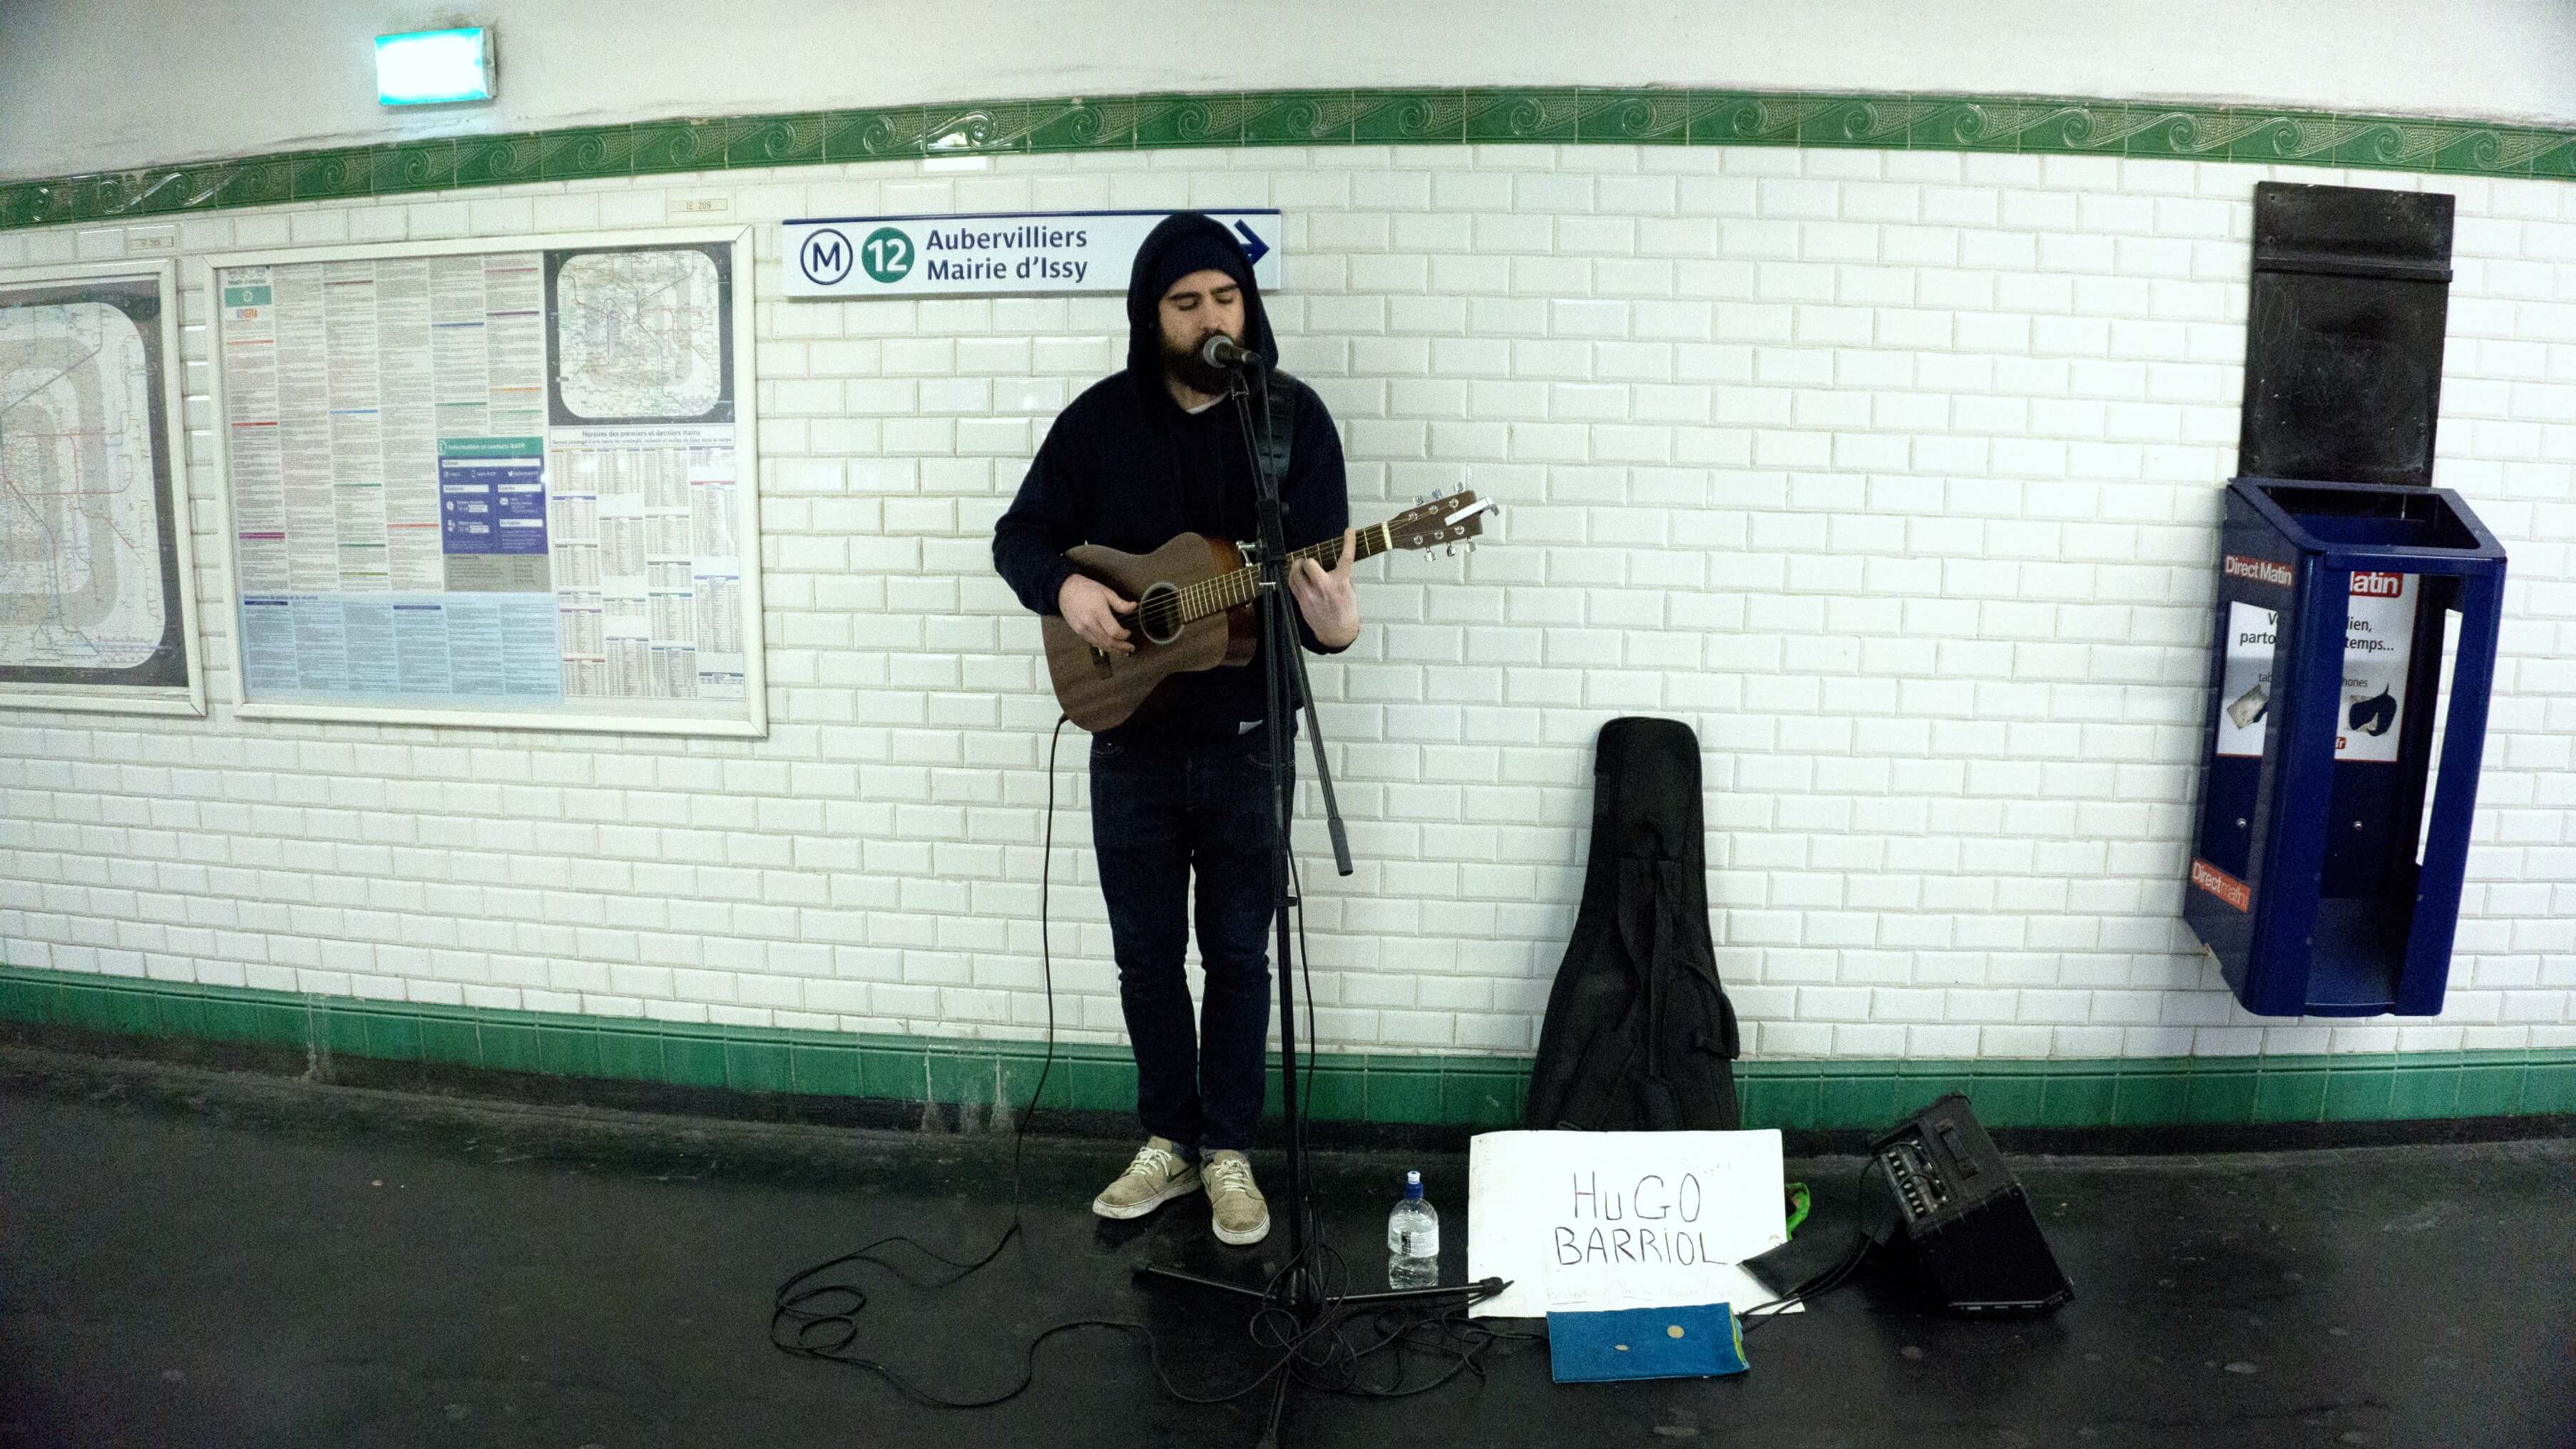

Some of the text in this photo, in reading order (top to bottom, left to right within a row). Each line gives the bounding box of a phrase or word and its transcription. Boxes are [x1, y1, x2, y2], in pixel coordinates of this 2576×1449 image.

[926, 225, 1088, 250] Aubervilliers
[867, 237, 907, 272] 12
[927, 257, 1007, 280] Mairie
[2225, 555, 2292, 585] Direct Matin
[2351, 571, 2398, 594] atin
